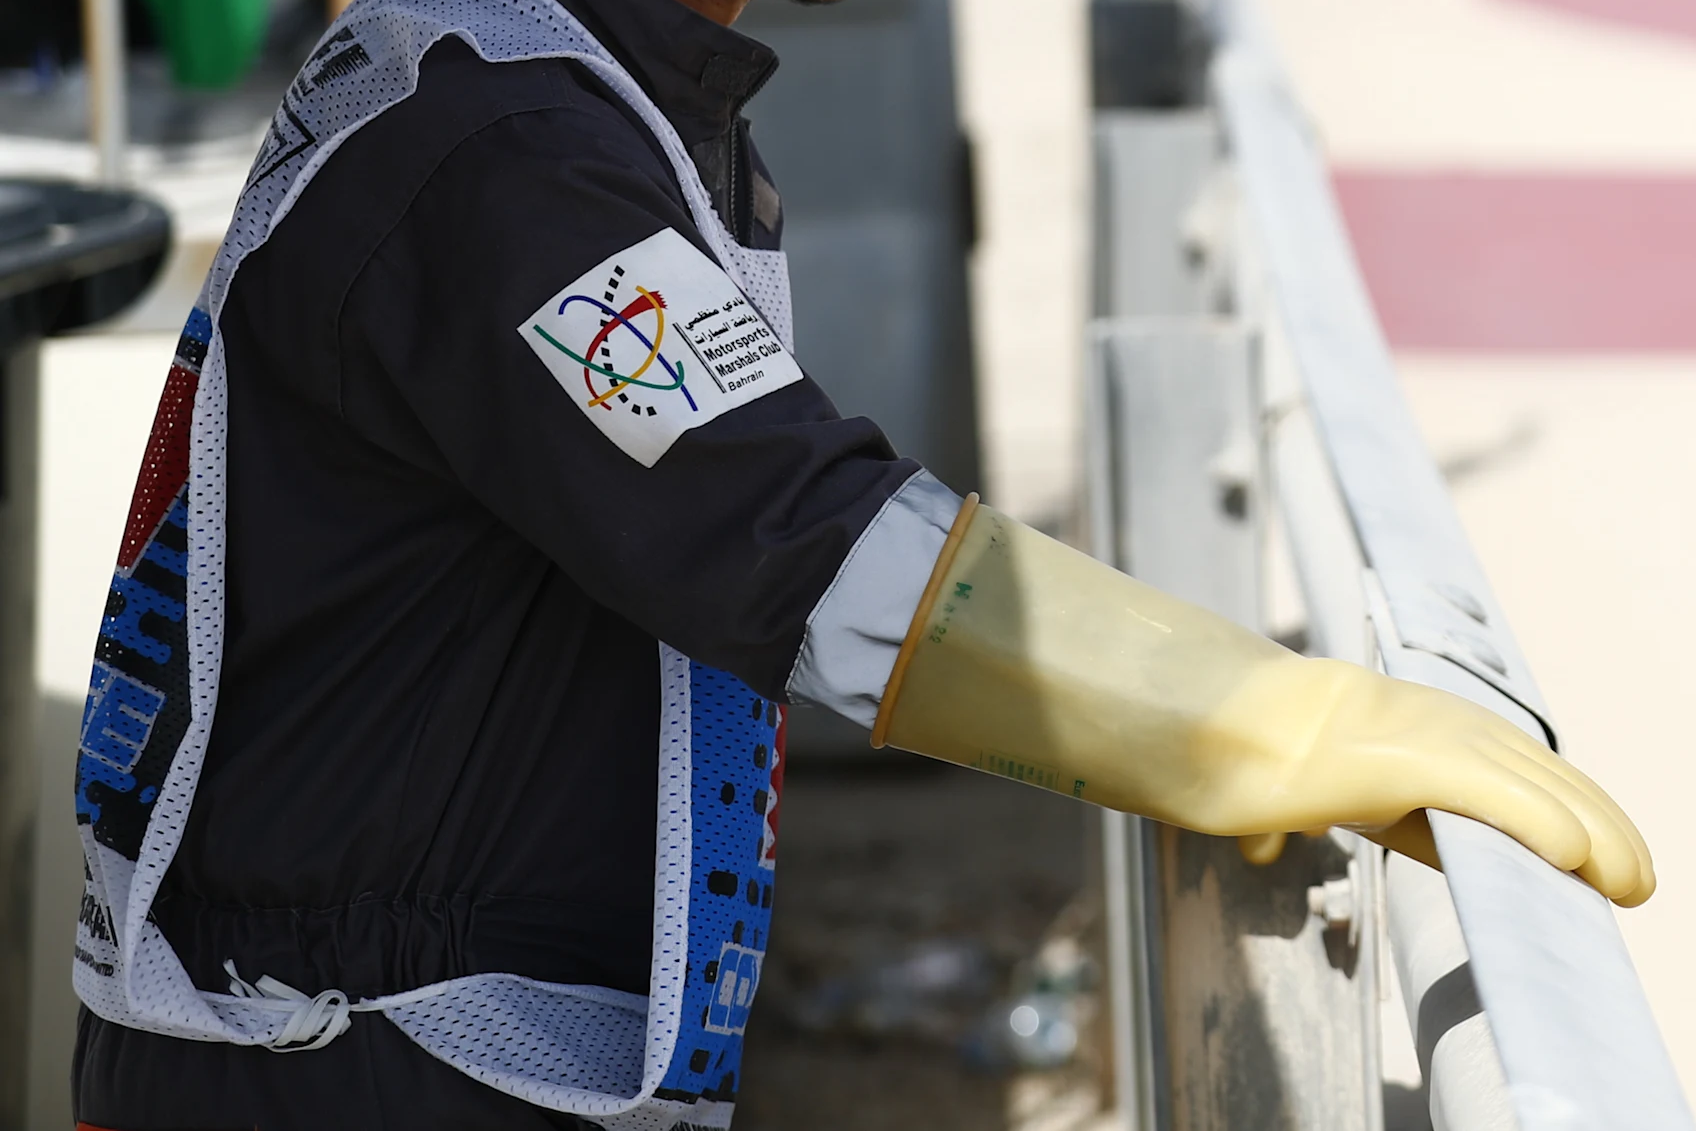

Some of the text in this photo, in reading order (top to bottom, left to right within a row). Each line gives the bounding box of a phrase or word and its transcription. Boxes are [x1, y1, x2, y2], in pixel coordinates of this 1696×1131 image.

[684, 296, 745, 331] نادي منظمي
[694, 313, 758, 345] رياضة السيارات
[703, 327, 770, 362] Motorsports
[714, 340, 782, 378] Marshals Club
[727, 368, 765, 392] Bahrain
